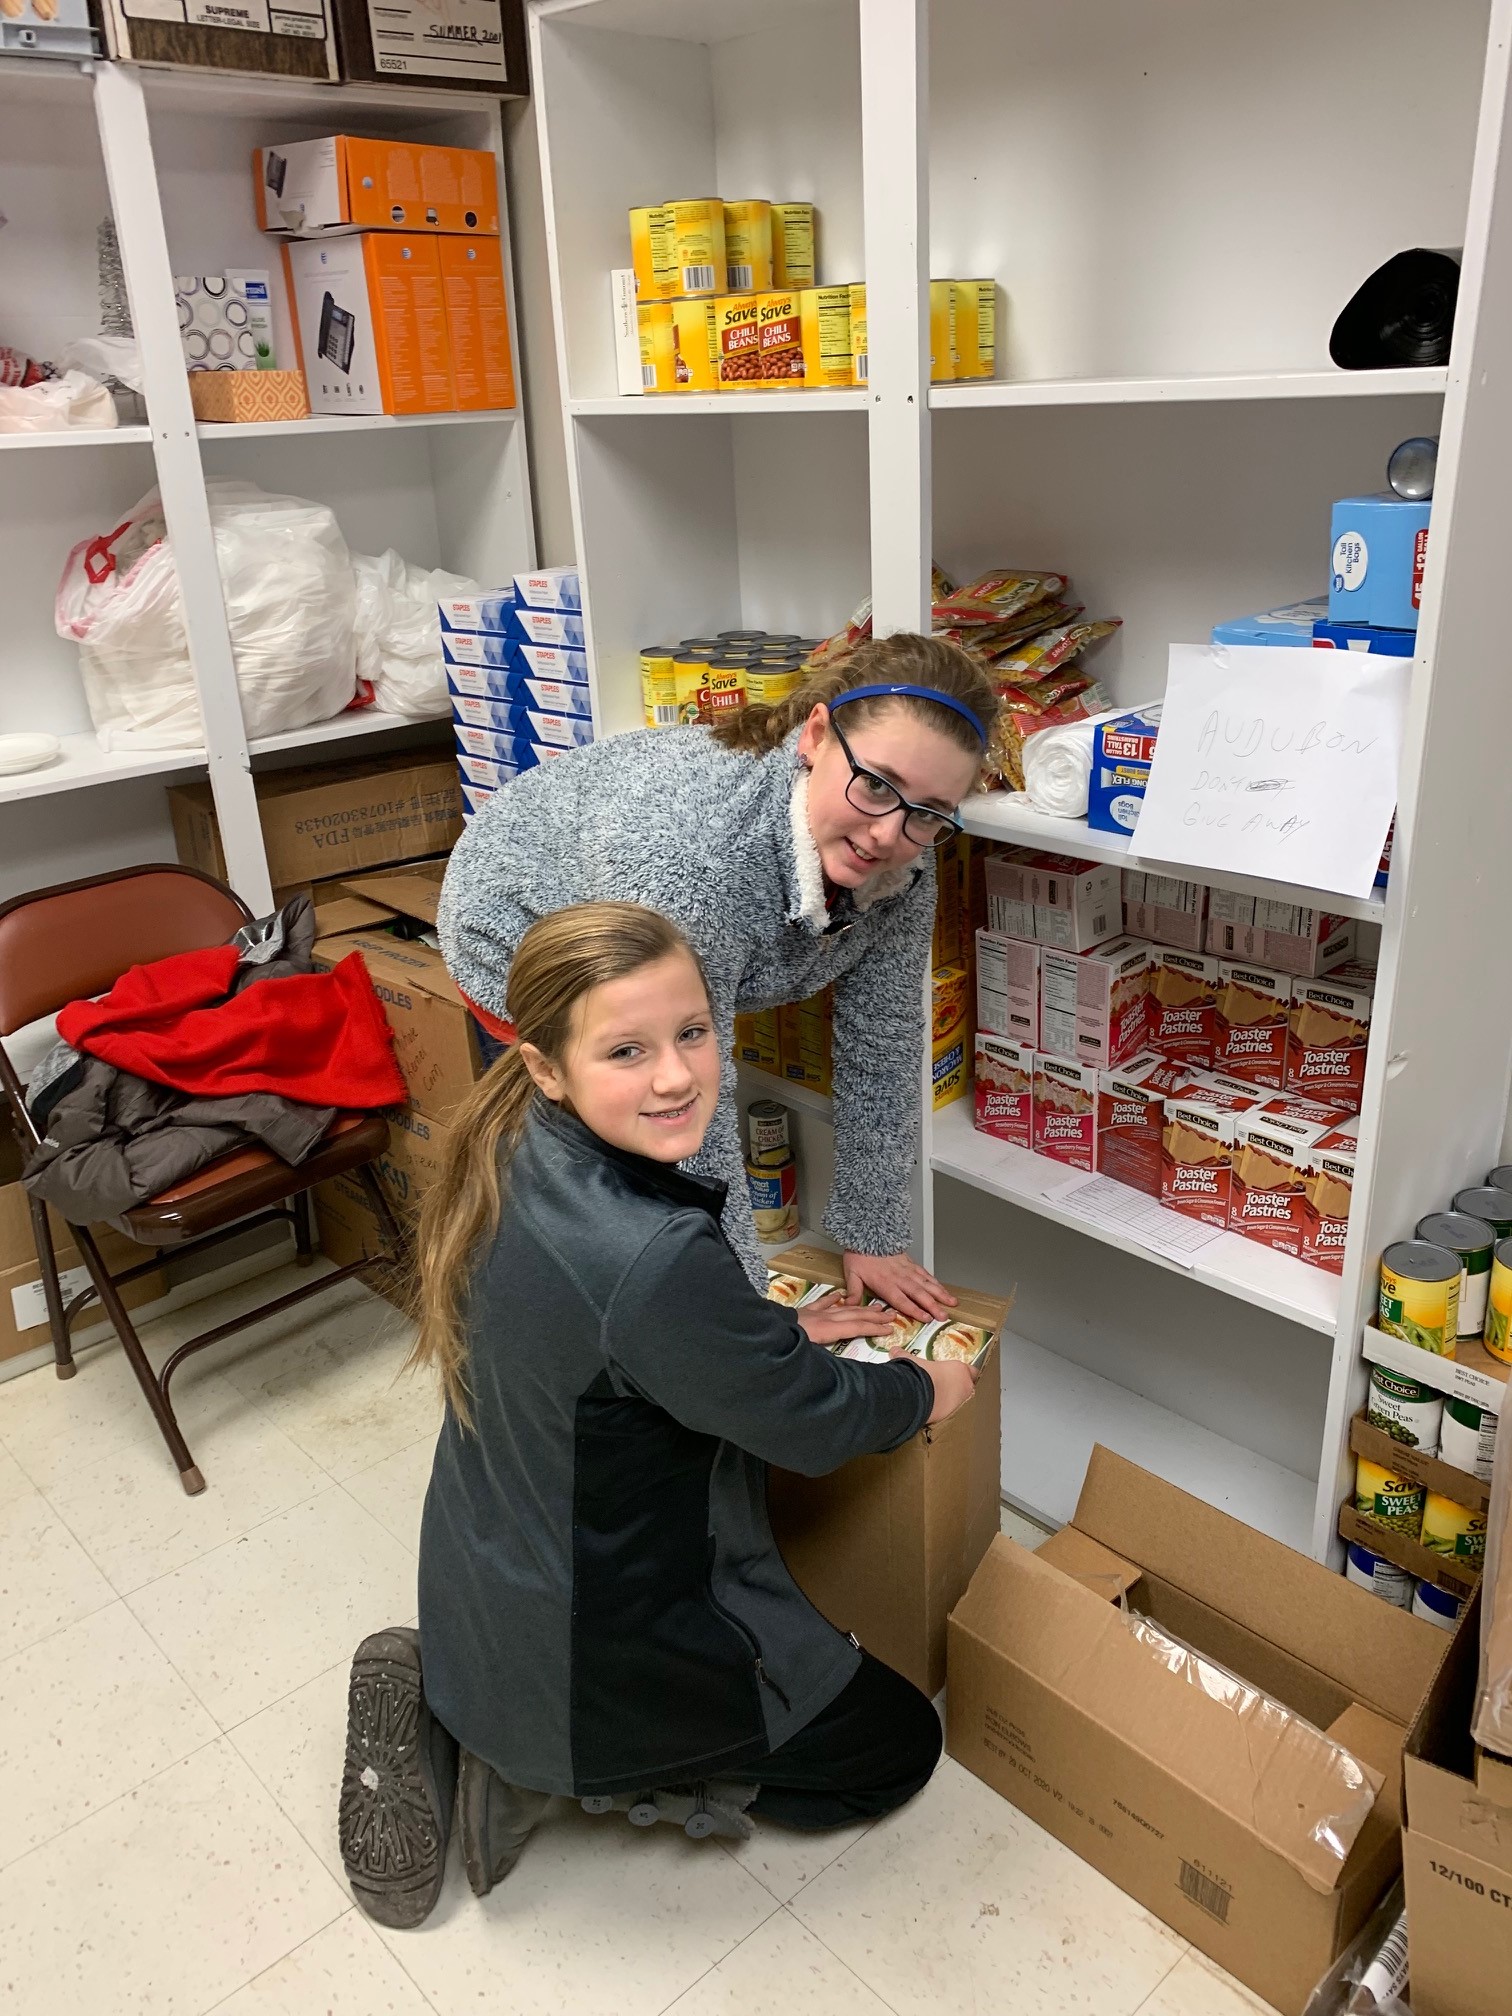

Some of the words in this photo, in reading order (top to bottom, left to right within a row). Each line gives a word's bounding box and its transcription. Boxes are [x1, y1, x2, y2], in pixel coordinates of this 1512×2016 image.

[205, 5, 250, 19] SUPREME
[429, 24, 483, 46] SUMMER
[380, 58, 408, 70] 65521
[766, 296, 792, 308] Always
[817, 293, 839, 301] Nutrition
[725, 306, 758, 326] Save
[760, 302, 792, 323] Save
[729, 327, 756, 341] CHILI
[764, 323, 788, 339] CHILI
[728, 334, 758, 351] BEANS
[762, 331, 792, 348] BEANS
[1345, 542, 1353, 574] Kitchen
[1353, 542, 1361, 563] Bags
[528, 579, 548, 588] STAPLES
[452, 603, 471, 613] STAPLES
[531, 615, 552, 626] STAPLES
[454, 636, 473, 647] STAPLES
[535, 650, 556, 661] STAPLES
[458, 668, 477, 679] STAPLES
[715, 671, 738, 681] Always
[540, 683, 560, 694] STAPLES
[711, 677, 738, 691] Save
[463, 699, 482, 710] STAPLES
[711, 692, 739, 708] CHILI
[542, 716, 562, 728] STAPLES
[466, 730, 485, 741] STAPLES
[1197, 709, 1378, 758] AUDUBON
[1106, 740, 1123, 750] TALL
[1122, 742, 1138, 757] 13
[470, 760, 488, 771] STAPLES
[1112, 774, 1131, 786] FLEX
[1117, 800, 1134, 811] Bags
[1117, 813, 1128, 822] Tall
[1182, 800, 1232, 828] GIVE
[1240, 813, 1311, 845] AWAY
[311, 828, 351, 850] FDA
[1045, 954, 1065, 964] Nutrition
[1164, 953, 1180, 964] Best
[1180, 956, 1203, 970] Choice
[1232, 971, 1249, 981] Best
[1248, 974, 1275, 988] Choice
[1308, 991, 1325, 1002] Best
[1325, 994, 1353, 1008] Choice
[1162, 1009, 1203, 1023] Toaster
[1149, 1027, 1155, 1037] 8
[1159, 1021, 1203, 1036] Pastries
[1229, 1028, 1273, 1043] Toaster
[986, 1042, 998, 1053] Best
[997, 1045, 1018, 1059] Choice
[1215, 1046, 1221, 1056] 8
[1225, 1040, 1273, 1056] Pastries
[933, 1051, 955, 1072] CHEESE
[1303, 1050, 1350, 1065] Toaster
[932, 1054, 963, 1081] MACARON
[1045, 1062, 1058, 1072] Best
[1058, 1065, 1081, 1079] Choice
[1288, 1068, 1295, 1078] 8
[1299, 1062, 1351, 1078] Pastries
[934, 1068, 961, 1096] Save
[1114, 1083, 1126, 1093] Best
[1125, 1087, 1148, 1102] Choice
[986, 1093, 1020, 1107] Toaster
[984, 1104, 1021, 1118] Pastries
[1112, 1101, 1147, 1116] Toaster
[1045, 1115, 1082, 1128] Toaster
[1110, 1112, 1148, 1126] Pastries
[1177, 1110, 1192, 1121] Best
[1192, 1114, 1218, 1131] Choice
[756, 1127, 776, 1137] CREAM
[757, 1134, 784, 1143] CHICKEN
[1035, 1129, 1040, 1139] 8
[1043, 1126, 1083, 1139] Pastries
[1055, 1142, 1075, 1152] Strawberry
[1075, 1144, 1091, 1152] Frosted
[1249, 1134, 1265, 1145] Best
[1265, 1139, 1293, 1155] Choice
[1175, 1166, 1218, 1181] Toaster
[1324, 1161, 1342, 1172] Best
[1162, 1181, 1168, 1191] 8
[1172, 1178, 1219, 1194] Pastries
[1245, 1191, 1291, 1207] Toaster
[1231, 1206, 1238, 1217] 8
[1241, 1203, 1292, 1220] Pastries
[1320, 1220, 1348, 1234] Toas
[1303, 1235, 1310, 1246] 8
[1386, 1377, 1417, 1396] Choice
[1377, 1394, 1402, 1413] Sweet
[1391, 1408, 1414, 1424] Peas
[1381, 1494, 1422, 1508] SWEET
[1386, 1503, 1419, 1516] PEAS
[1018, 1764, 1031, 1779] OCT
[1033, 1774, 1050, 1793] 2020
[1052, 1788, 1064, 1803] V2
[1429, 1859, 1485, 1897] 12/100
